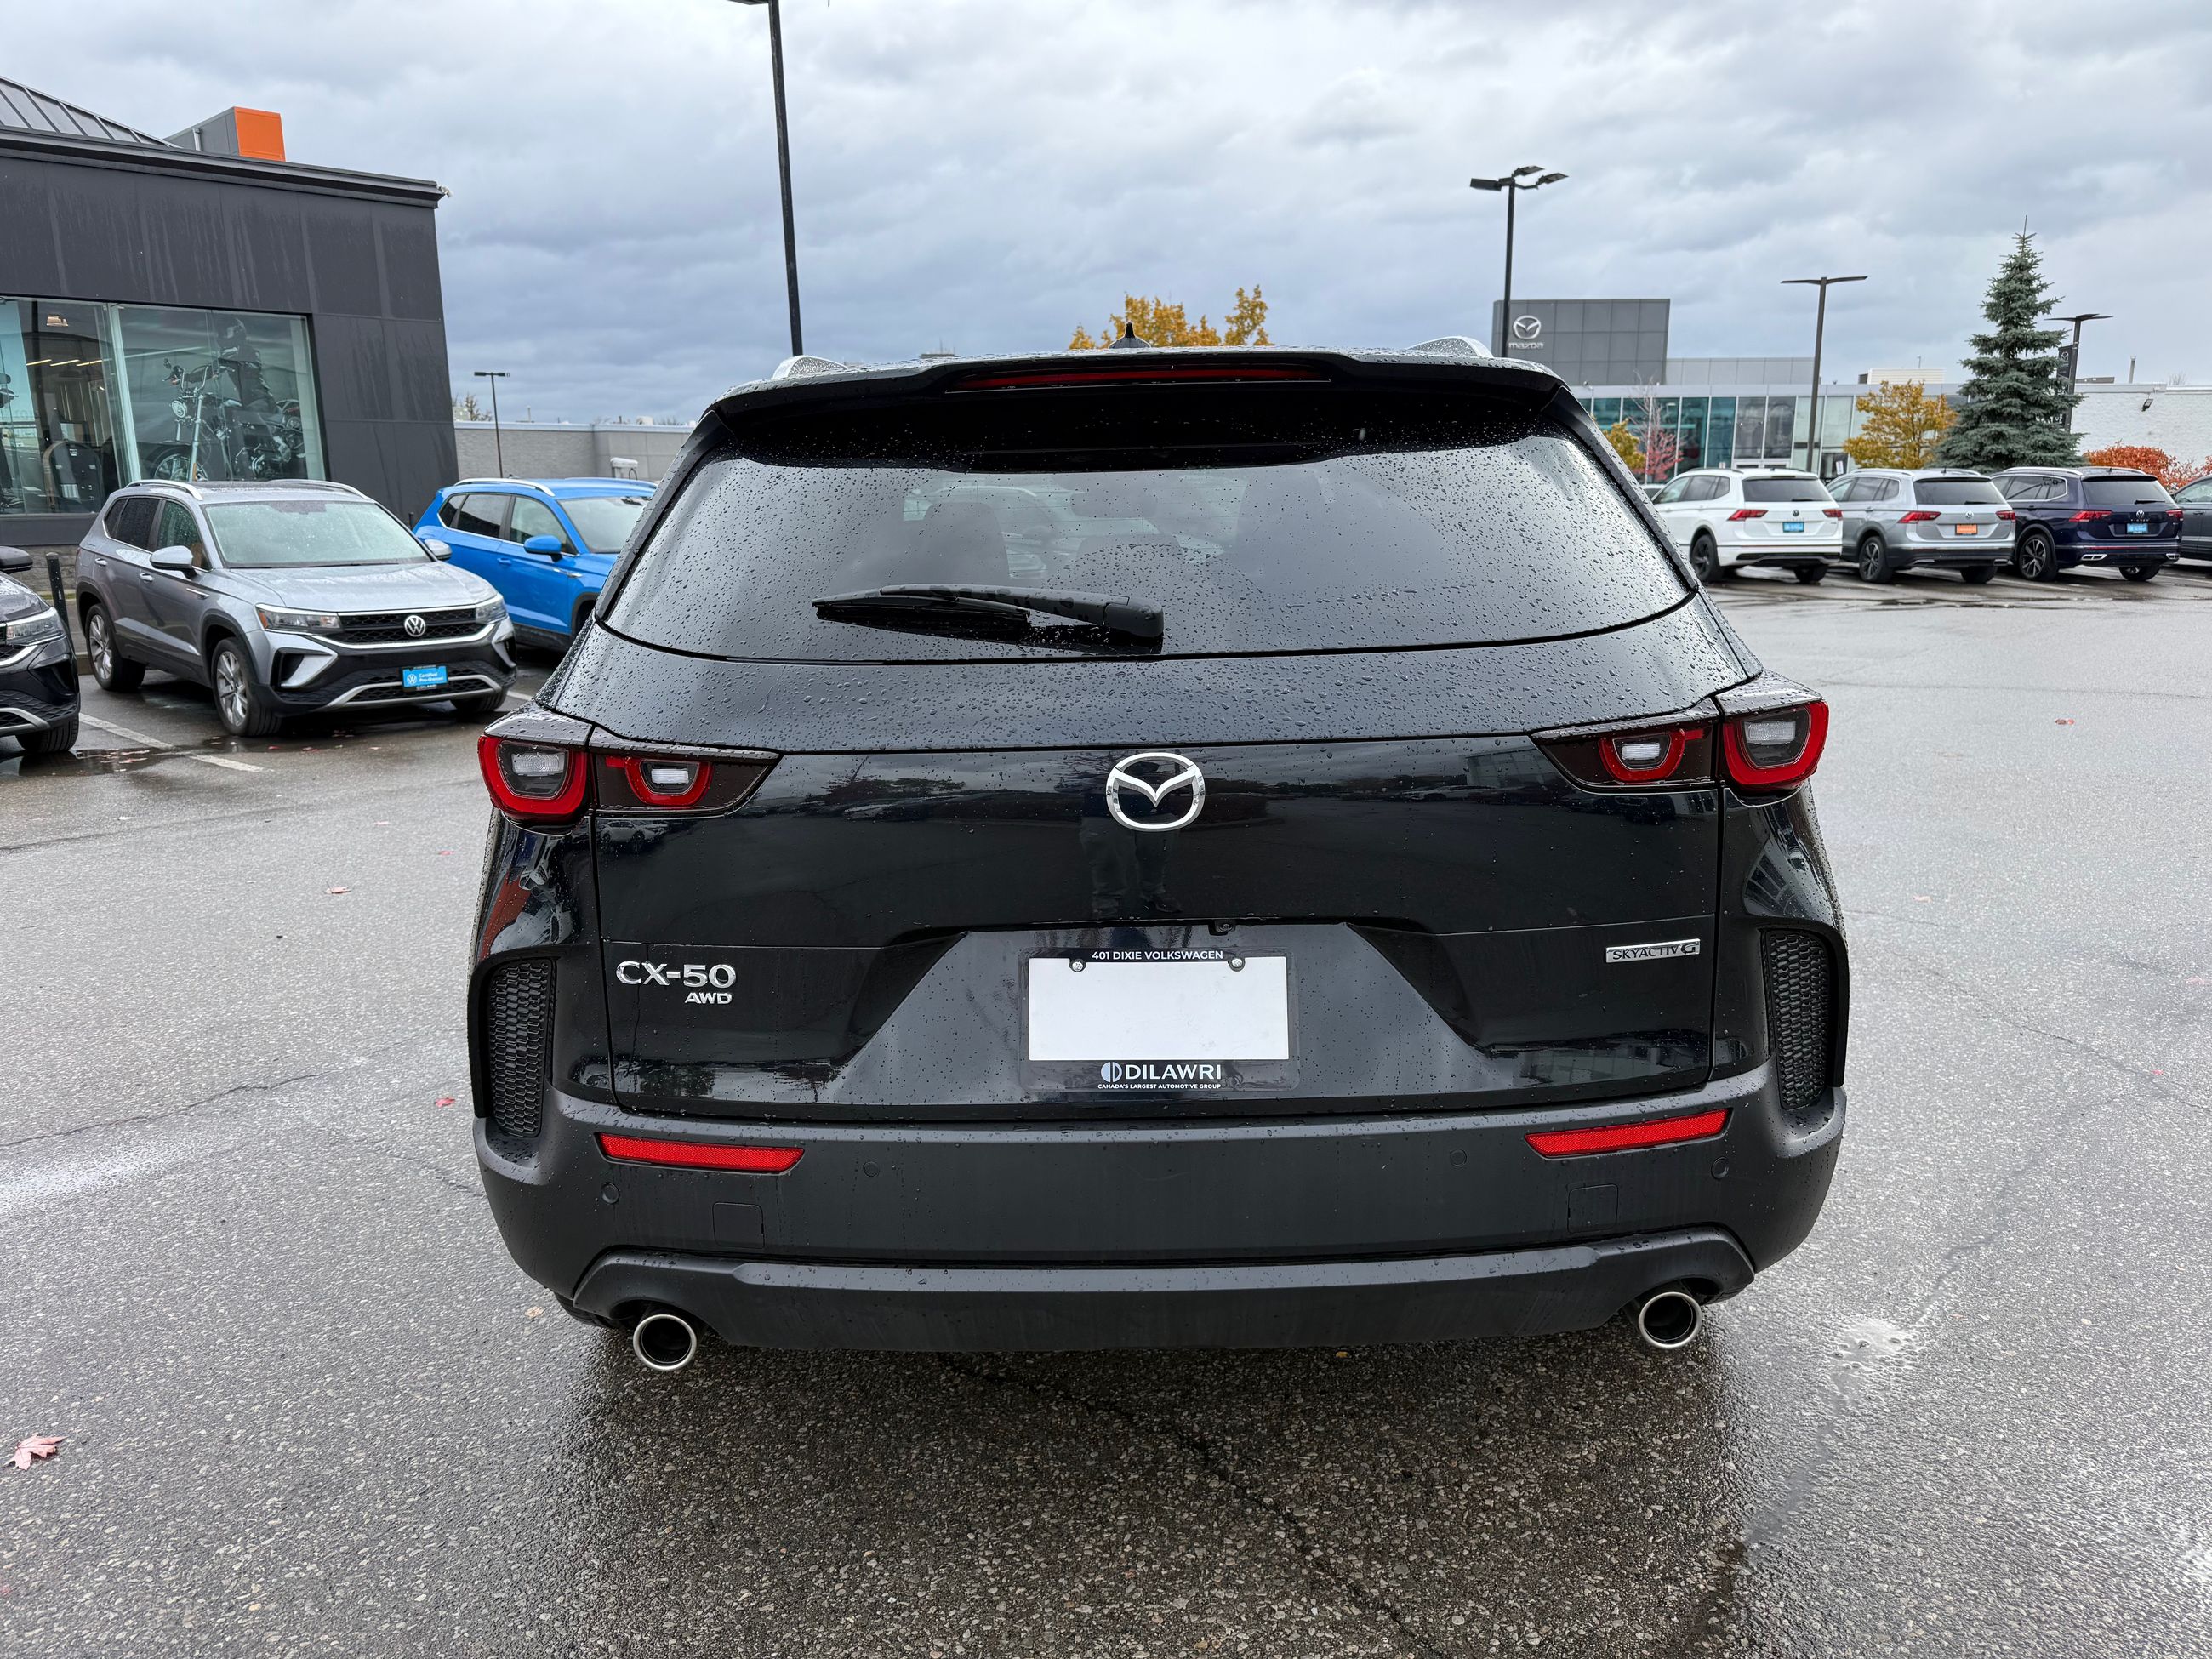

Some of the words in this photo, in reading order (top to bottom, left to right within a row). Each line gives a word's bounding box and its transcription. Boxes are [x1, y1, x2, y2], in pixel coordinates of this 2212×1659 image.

[1092, 951, 1109, 960] 401
[1113, 951, 1142, 960] DIXIE
[1144, 950, 1223, 960] VOLKSWAGEN
[616, 960, 737, 989] CX-50
[684, 992, 733, 1005] AWD
[1125, 1064, 1222, 1080] DILAWRI
